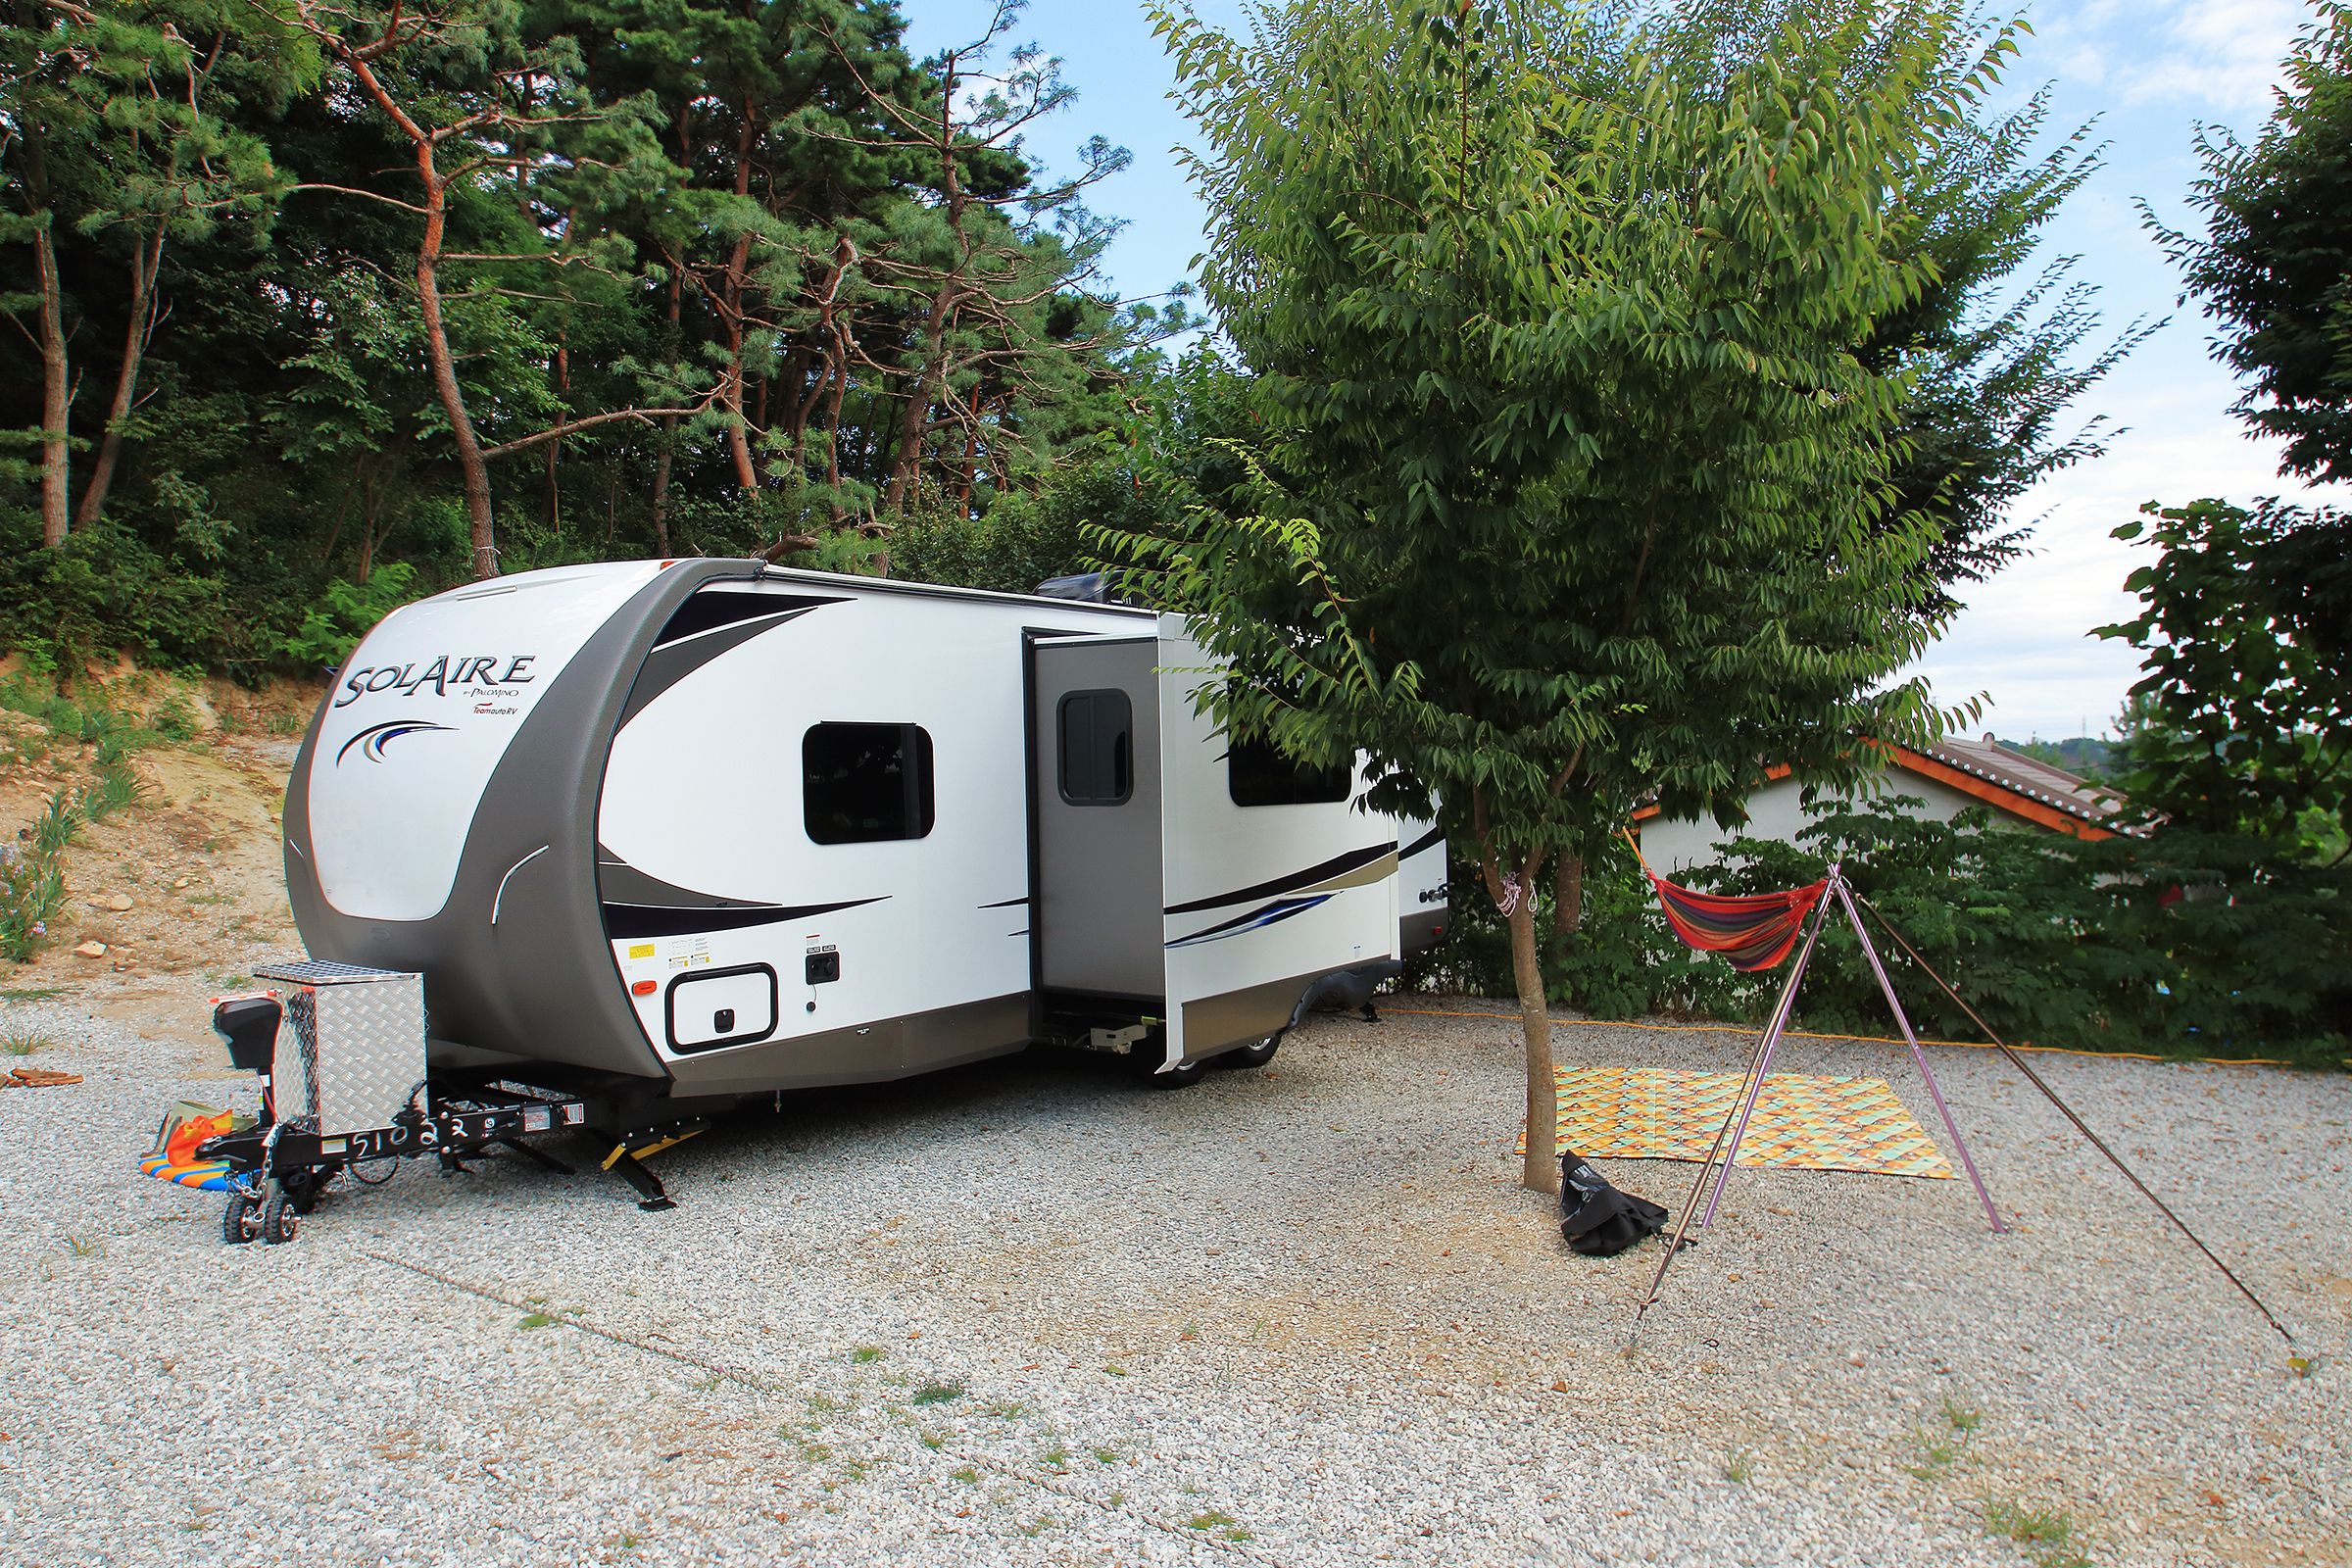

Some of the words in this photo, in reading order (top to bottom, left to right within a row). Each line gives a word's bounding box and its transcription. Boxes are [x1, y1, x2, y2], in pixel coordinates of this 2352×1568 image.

[334, 655, 536, 708] SOLAIRE
[470, 687, 519, 698] PALOMINO
[506, 707, 519, 715] RV
